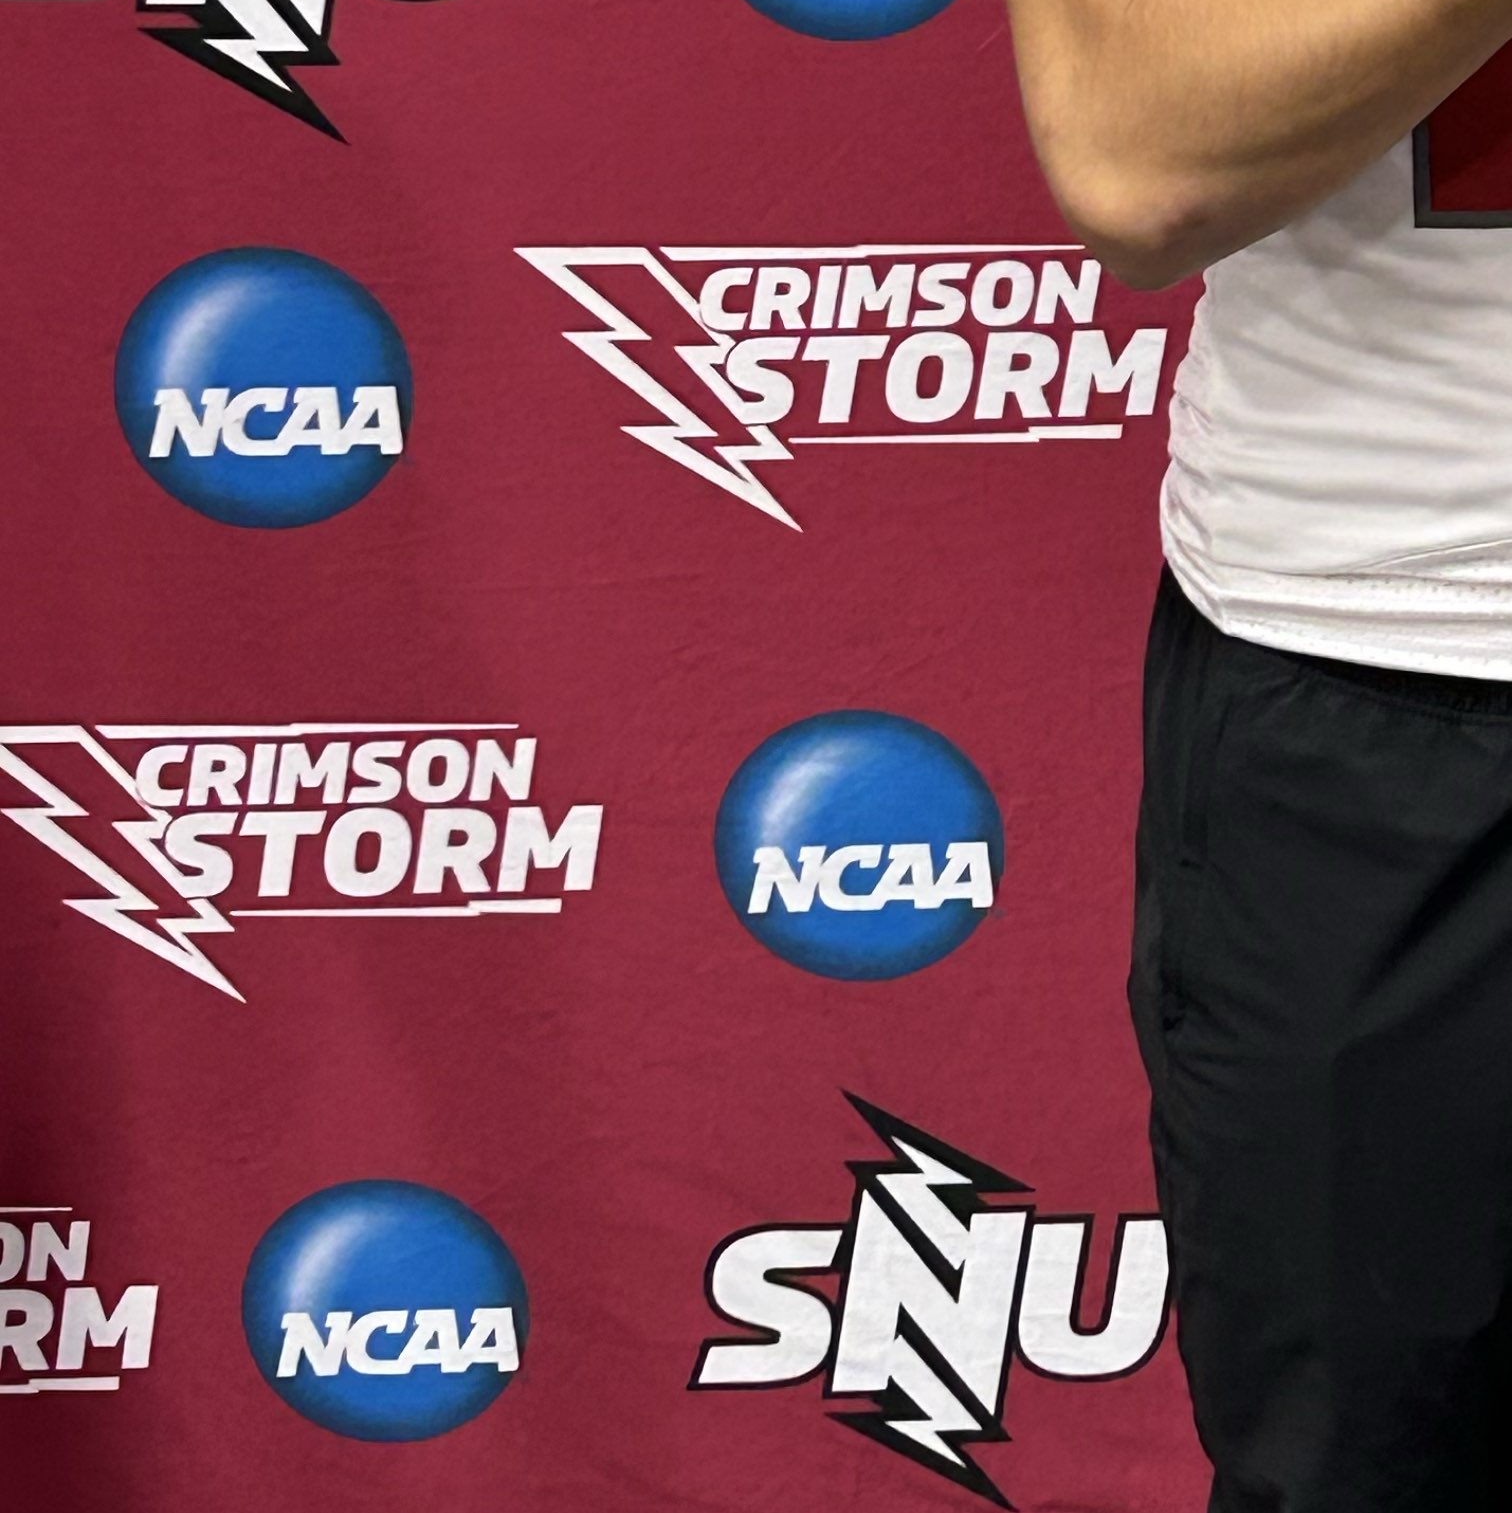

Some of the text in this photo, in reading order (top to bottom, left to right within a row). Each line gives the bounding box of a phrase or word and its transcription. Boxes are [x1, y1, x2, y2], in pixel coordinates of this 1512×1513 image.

[698, 259, 1101, 332] CRIMSON
[724, 328, 1168, 426] STORM
[149, 385, 403, 459] NCAA
[134, 736, 537, 810] CRIMSON
[165, 804, 603, 899] STORM
[747, 841, 994, 915] NCAA
[693, 1131, 1172, 1472] SNU
[276, 1305, 519, 1378] NCAA
